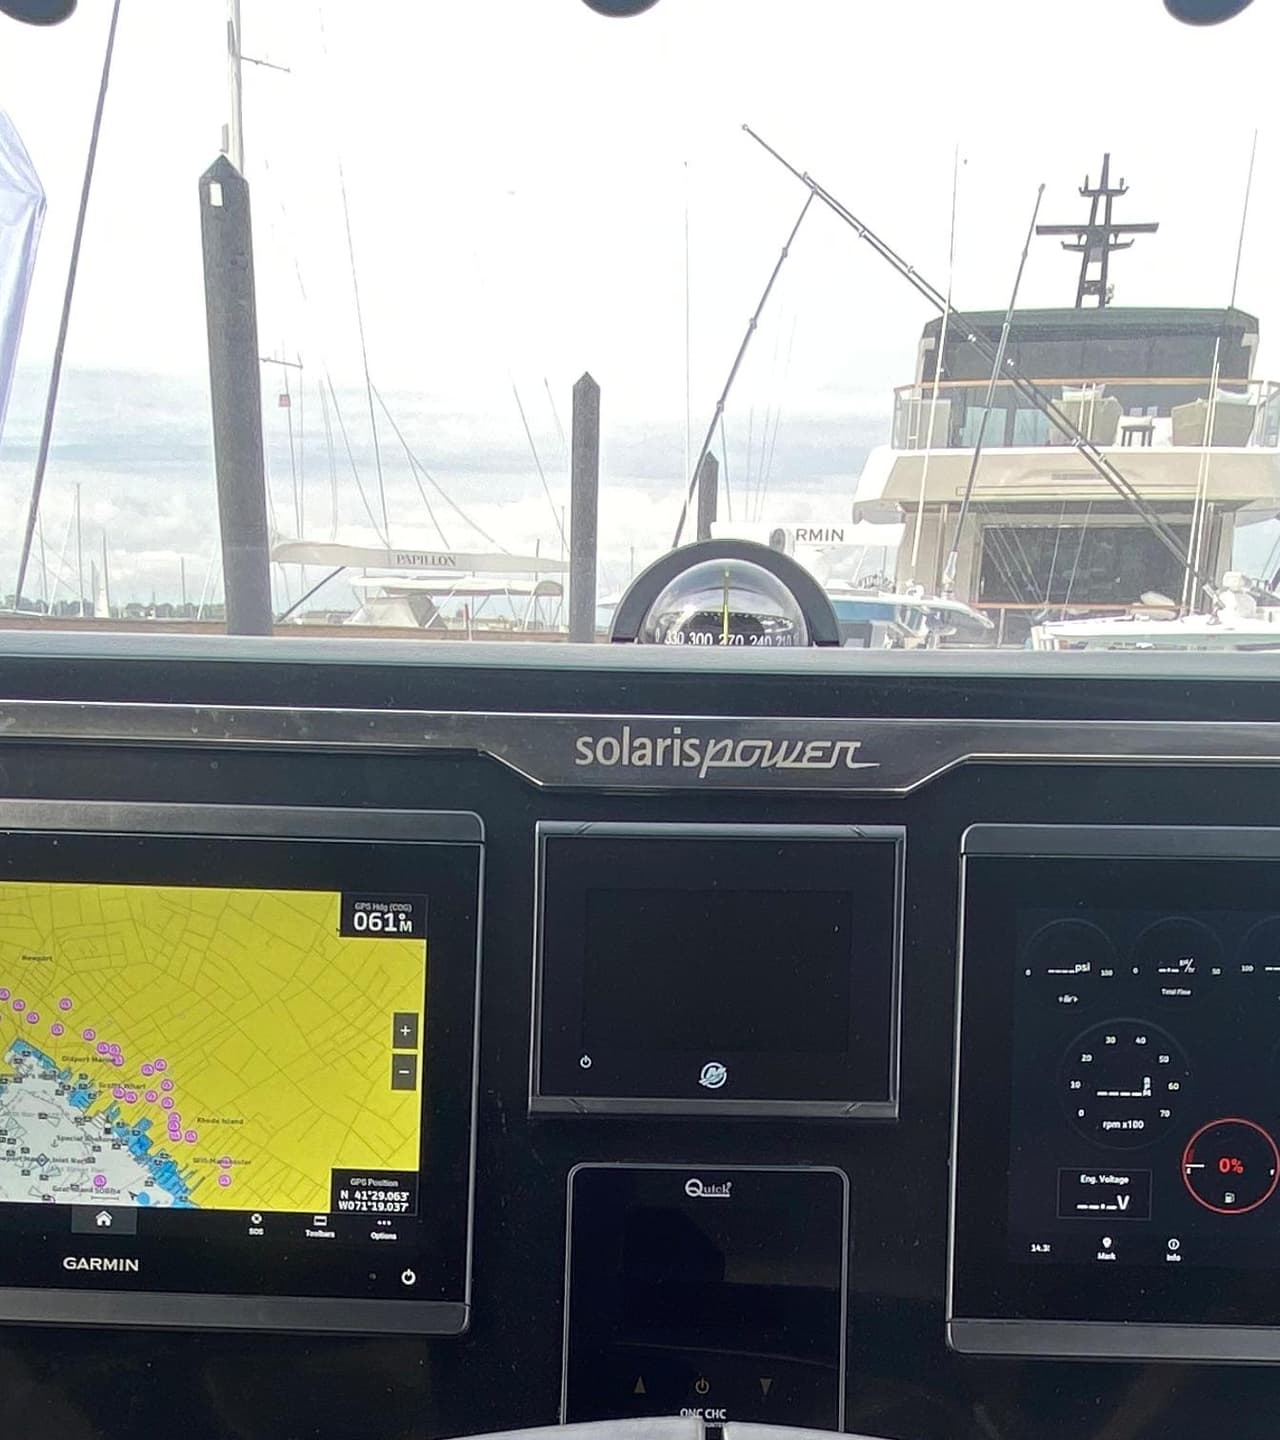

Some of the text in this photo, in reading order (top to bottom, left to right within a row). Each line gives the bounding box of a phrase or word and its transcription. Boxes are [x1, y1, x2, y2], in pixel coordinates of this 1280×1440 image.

[795, 528, 845, 542] RMIN
[396, 553, 457, 568] PAPILLON
[688, 632, 714, 646] 300
[1074, 962, 1091, 974] psi
[1102, 1121, 1121, 1130] rpm
[1219, 1157, 1245, 1175] 0%
[1099, 1173, 1130, 1186] Voltage
[340, 1189, 349, 1200] N
[684, 1177, 733, 1198] Quick
[62, 1256, 139, 1272] GARMIN
